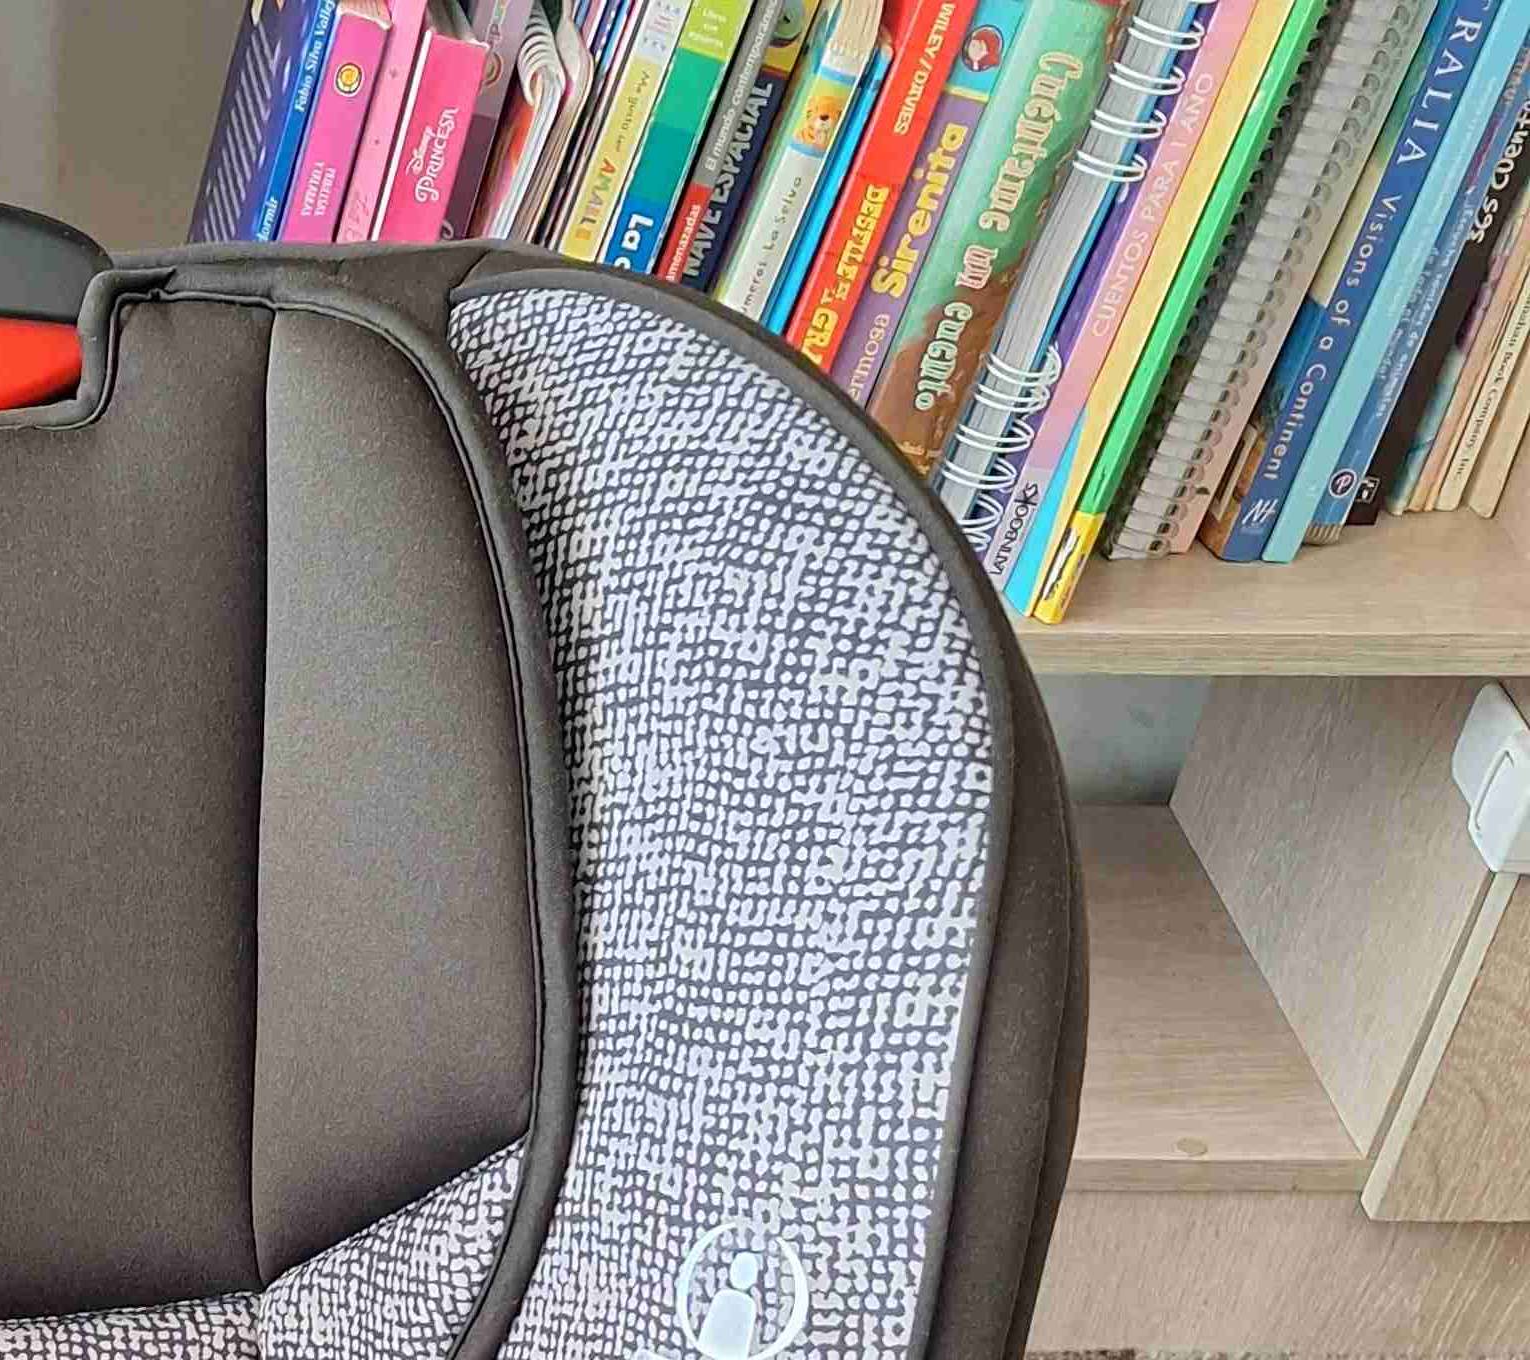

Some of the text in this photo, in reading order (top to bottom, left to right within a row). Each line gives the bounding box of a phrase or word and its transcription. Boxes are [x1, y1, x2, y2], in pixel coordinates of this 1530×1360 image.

[926, 2, 956, 59] WILEY
[714, 108, 735, 156] mundo
[894, 70, 929, 136] DAVIES
[682, 81, 773, 278] NAVE ESPACIAL
[621, 213, 654, 251] La
[848, 123, 968, 400] ermosa Sirenita
[1091, 229, 1148, 337] CUENTOS
[1143, 159, 1180, 222] PARA
[1263, 0, 1490, 481] RALIA Visions of a Continent
[955, 244, 998, 290] un
